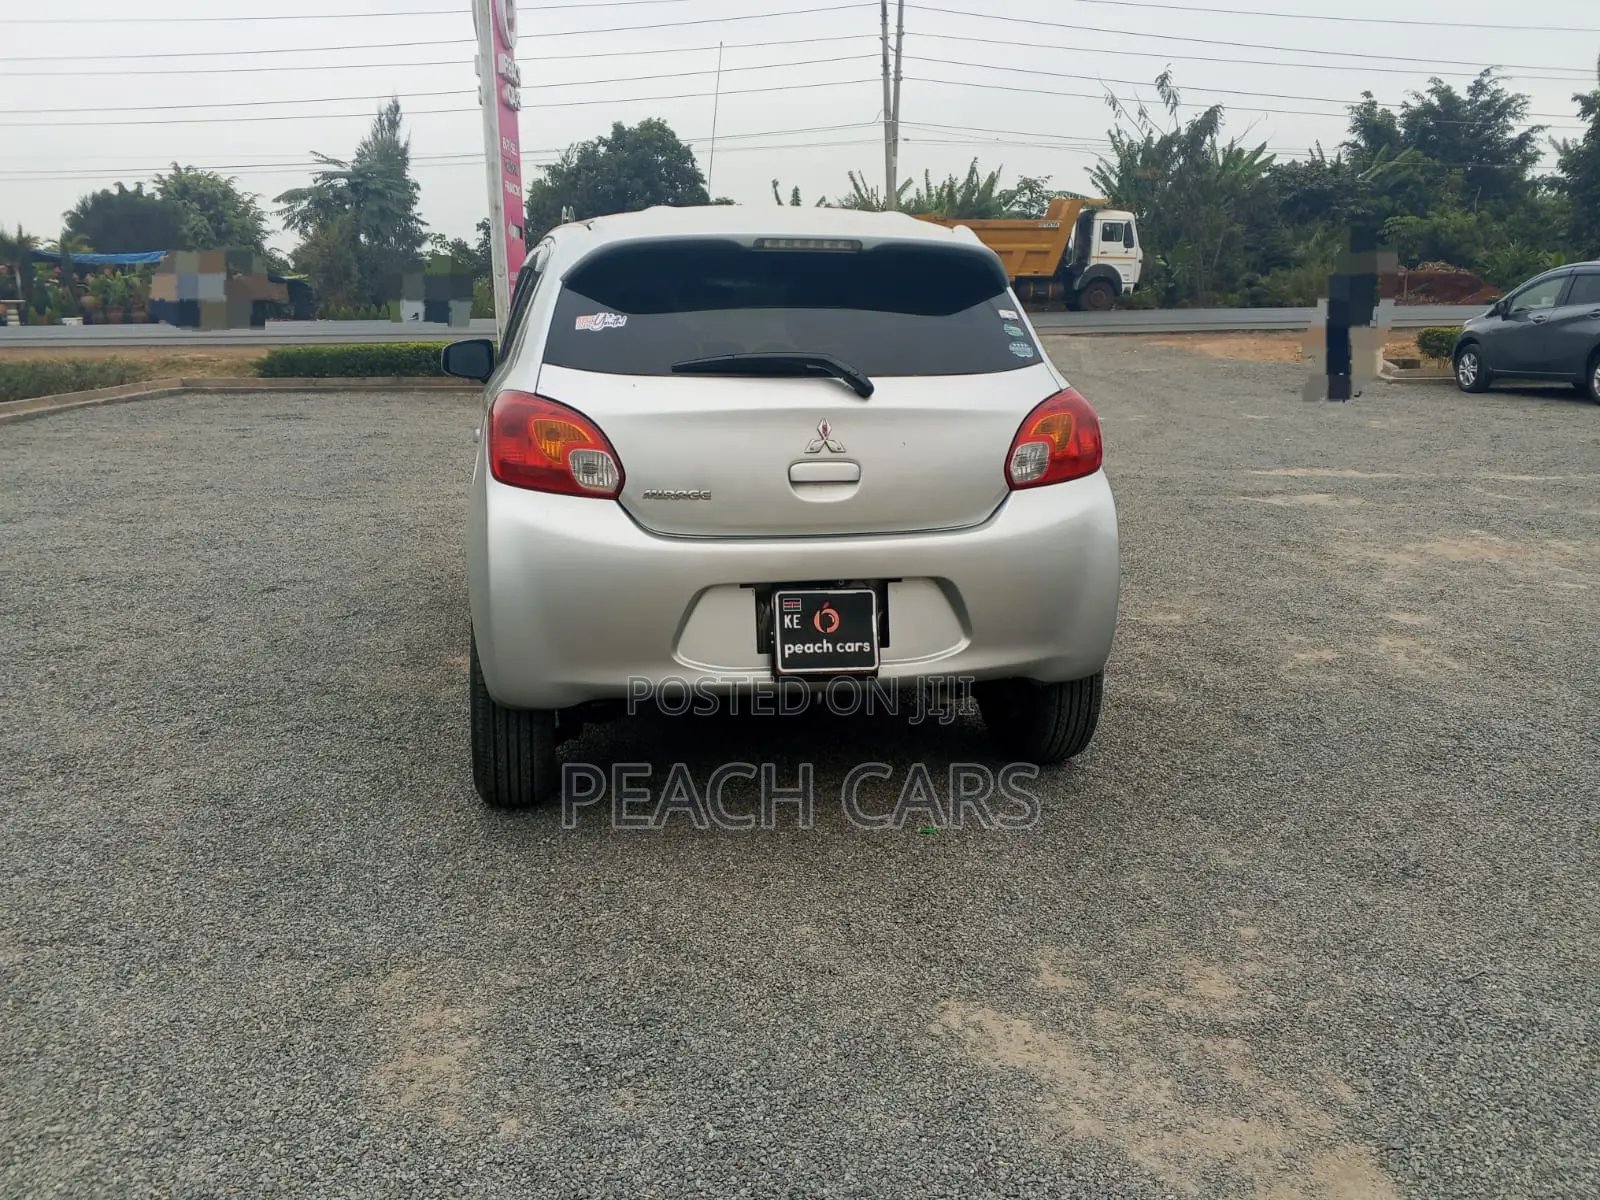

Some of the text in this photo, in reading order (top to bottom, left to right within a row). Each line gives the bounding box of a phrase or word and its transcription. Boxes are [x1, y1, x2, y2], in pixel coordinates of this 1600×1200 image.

[784, 614, 801, 628] KE
[784, 639, 870, 658] peach cars
